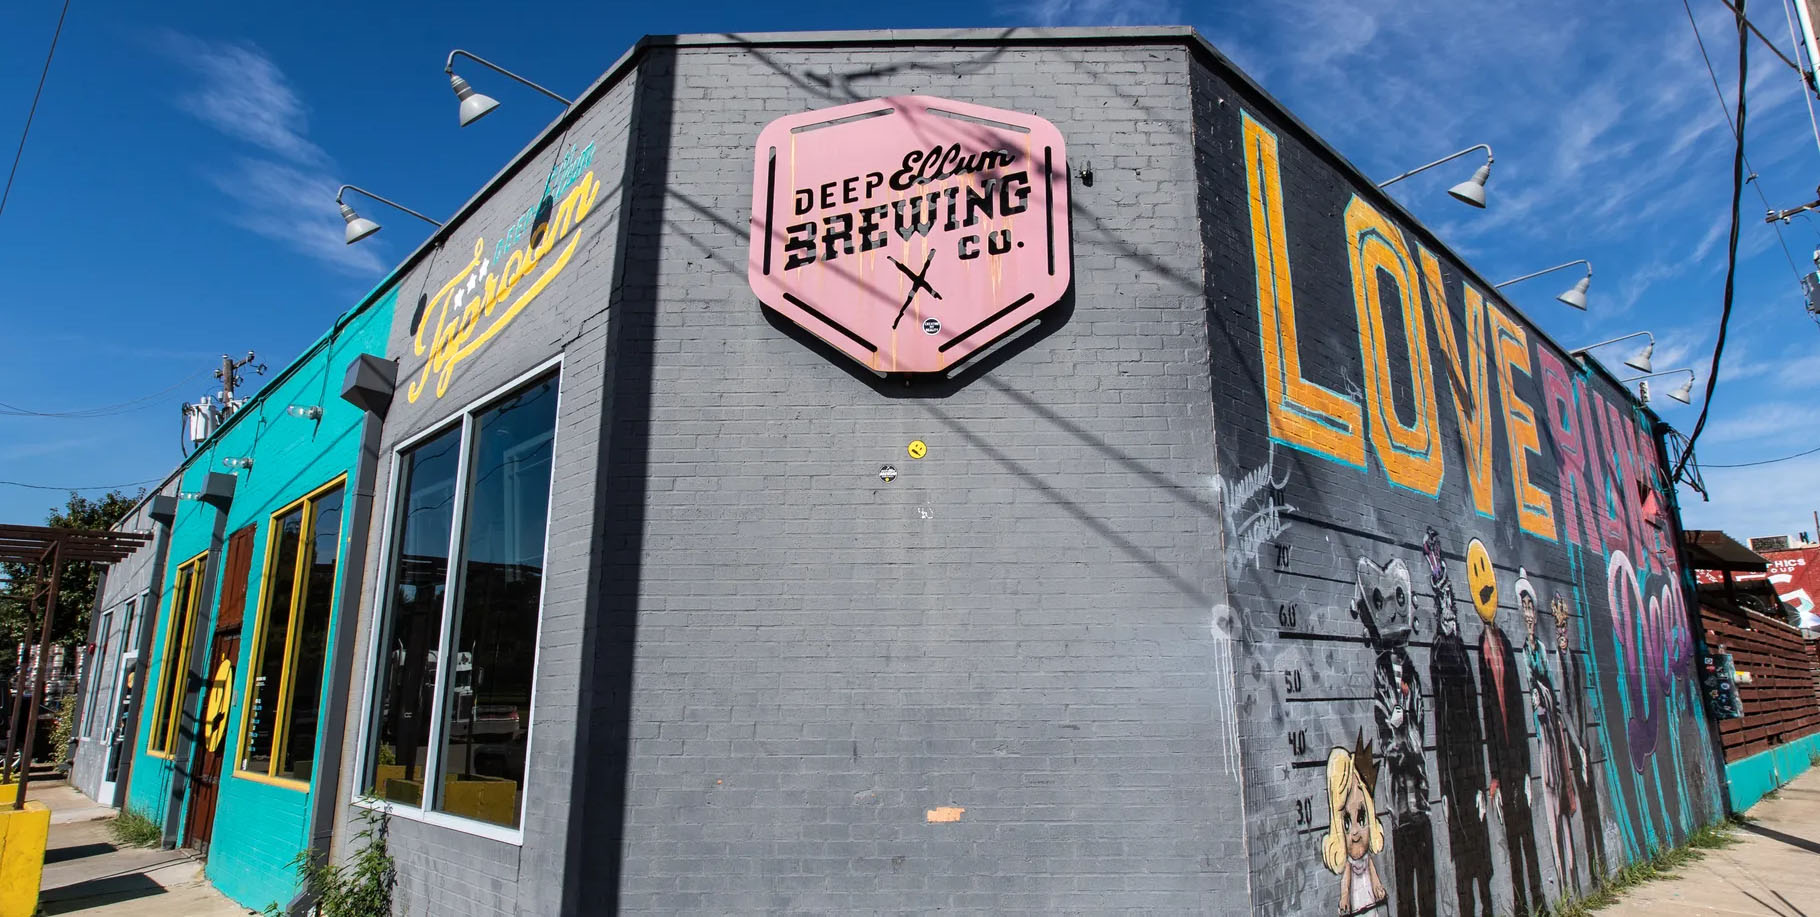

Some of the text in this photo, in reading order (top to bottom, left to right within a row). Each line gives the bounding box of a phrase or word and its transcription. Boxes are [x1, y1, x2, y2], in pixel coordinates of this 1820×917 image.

[784, 170, 1032, 271] BREWING
[794, 142, 1016, 216] DEEP Ellum
[957, 229, 1025, 261] CO.
[1239, 107, 1558, 544] LOVE
